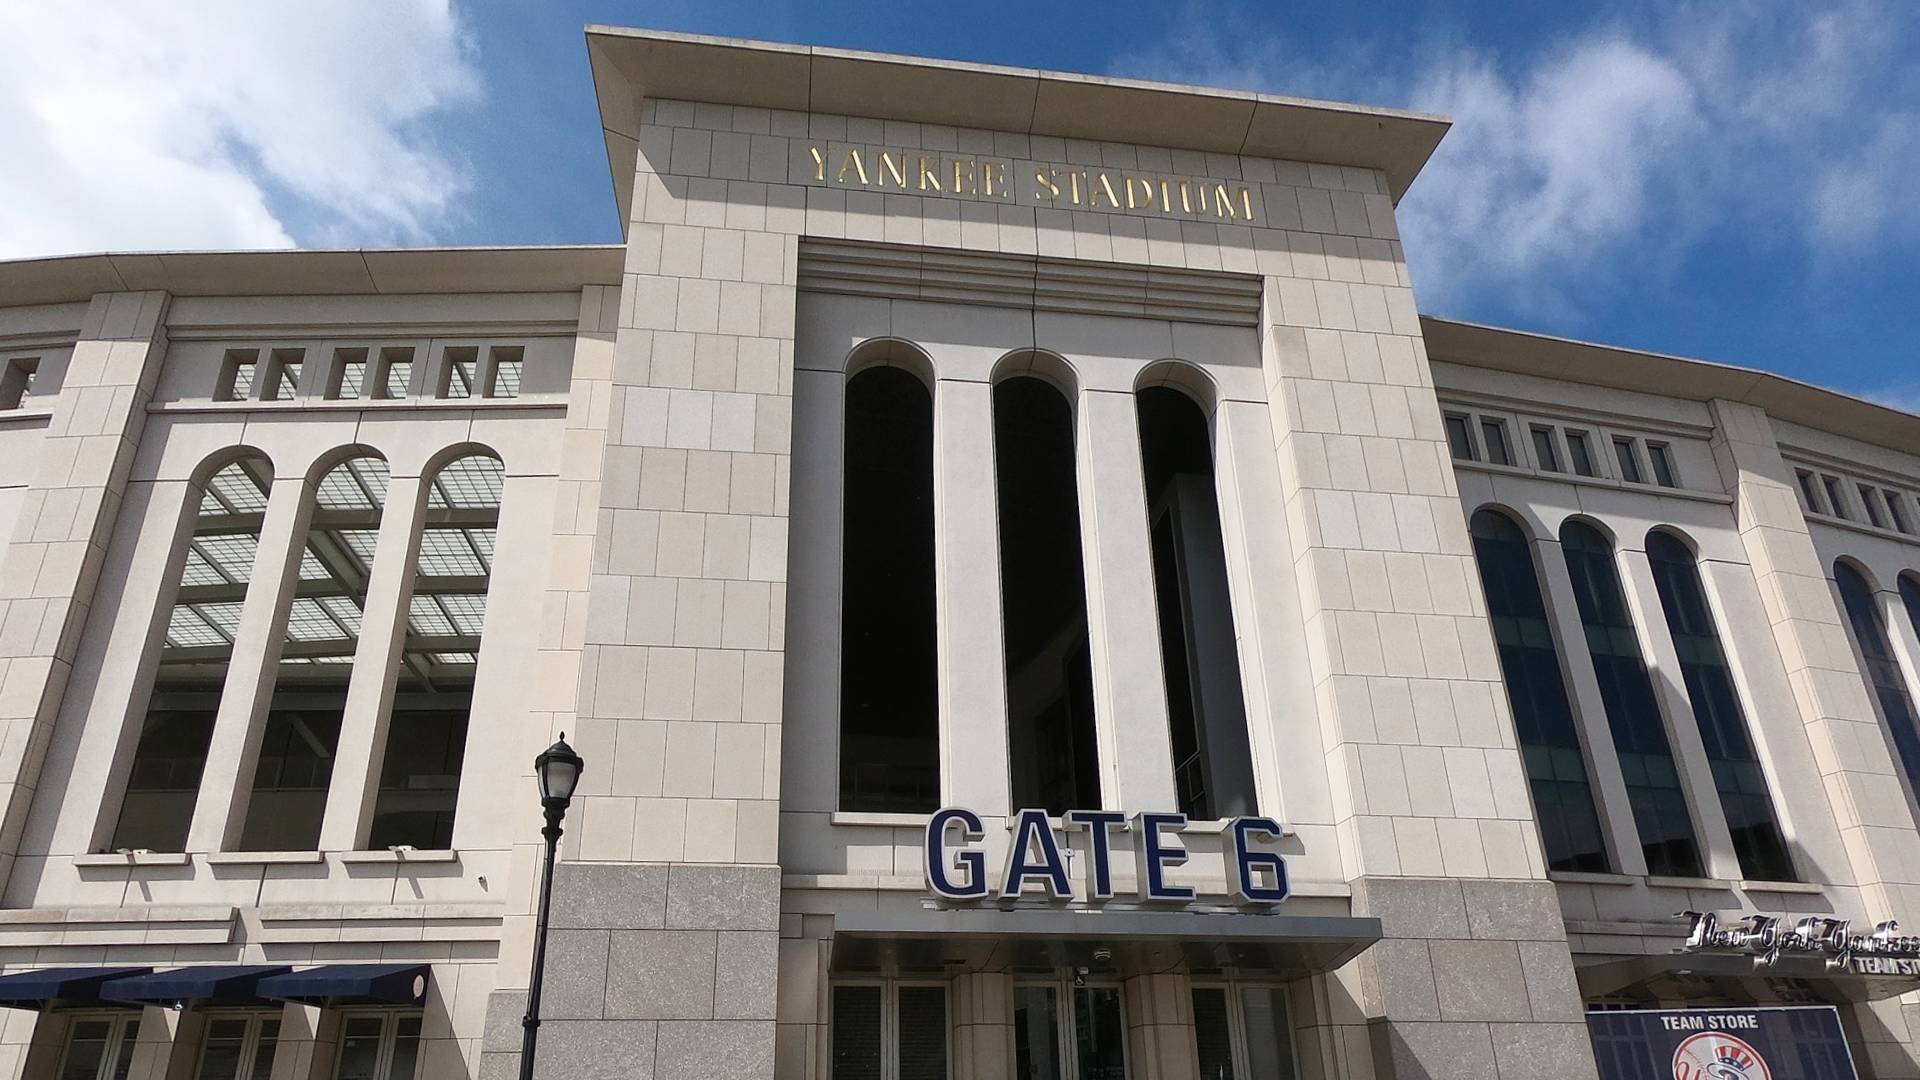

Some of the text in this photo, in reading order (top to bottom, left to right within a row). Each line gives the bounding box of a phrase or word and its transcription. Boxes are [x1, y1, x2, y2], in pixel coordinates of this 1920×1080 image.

[809, 147, 1255, 220] YANKEE STADIUM
[924, 807, 1291, 904] GATE 6
[1672, 911, 1749, 947] New
[1741, 915, 1823, 967] York
[1852, 957, 1900, 974] TEAM
[1661, 1015, 1758, 1030] TEAM STORE
